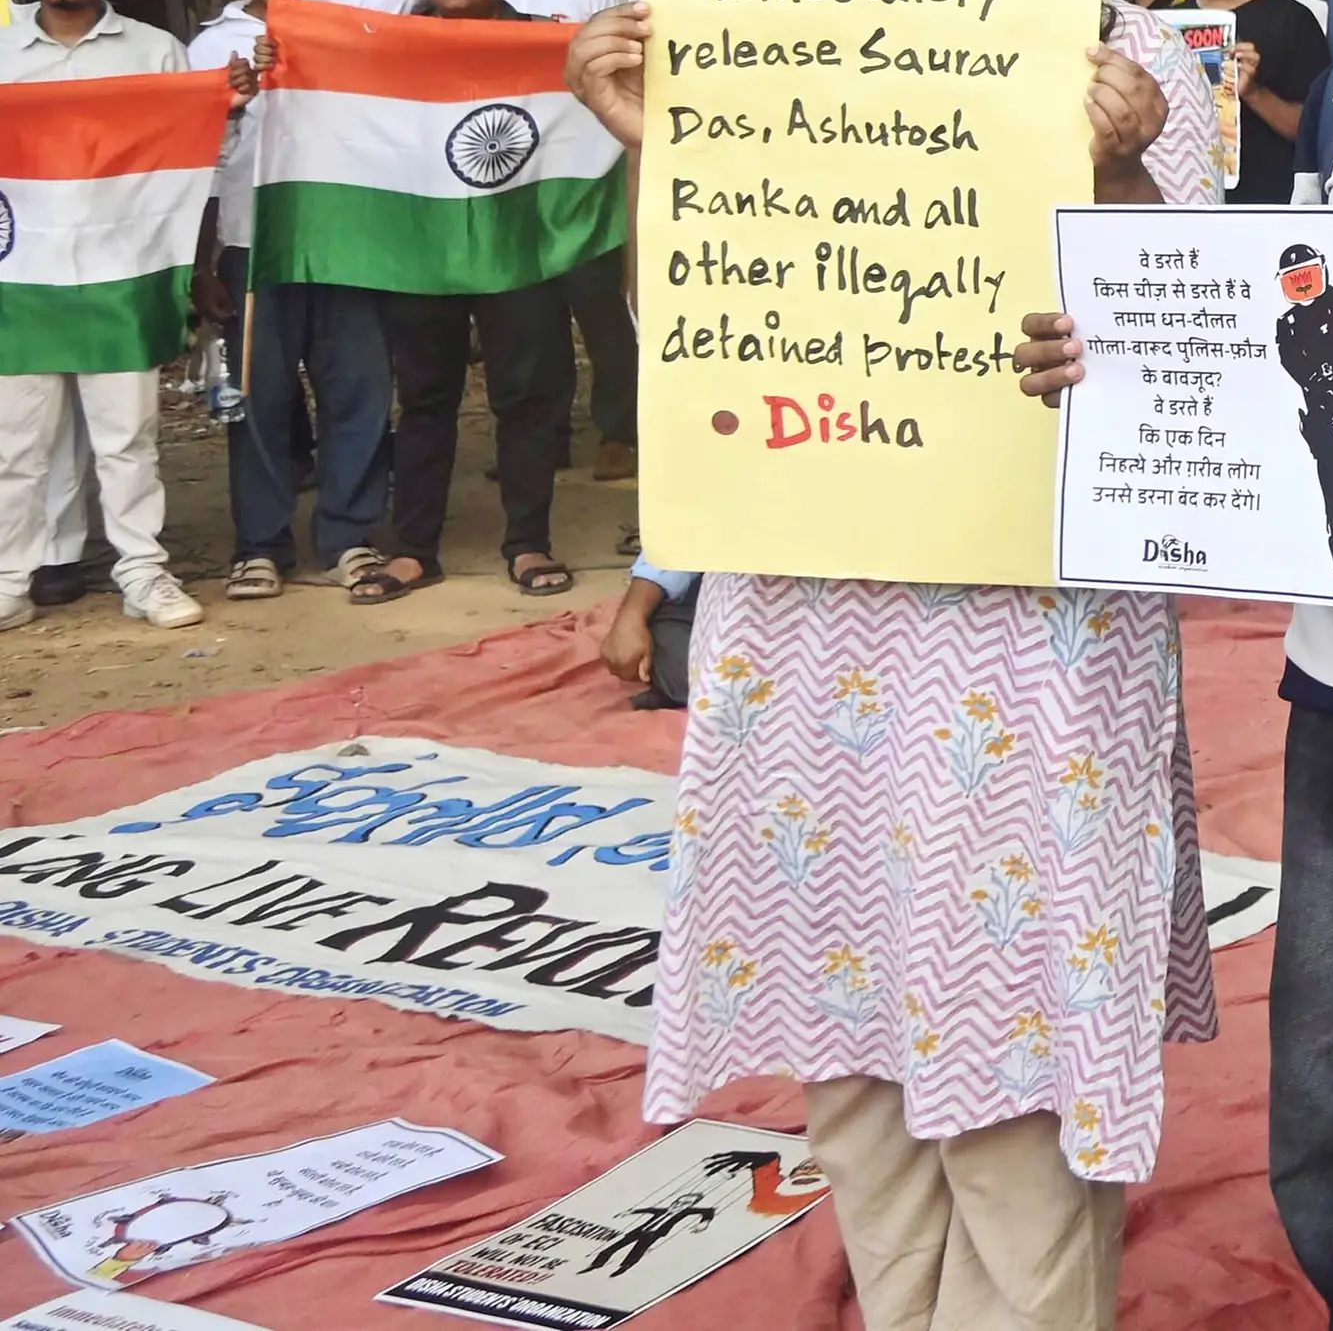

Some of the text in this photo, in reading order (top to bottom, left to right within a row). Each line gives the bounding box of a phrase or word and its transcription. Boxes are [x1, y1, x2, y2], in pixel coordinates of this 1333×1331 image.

[1184, 26, 1230, 48] SOON!
[668, 28, 1020, 78] release Saurav
[668, 99, 978, 156] Das, Ashutosh
[671, 178, 979, 228] Ranka and all
[1138, 247, 1200, 269] वे डरते हैं
[815, 242, 1005, 324] illegally
[1093, 277, 1251, 301] किस चीज़ से डरते हैं वे
[1113, 307, 1237, 329] तमाम धन-दौलत
[661, 310, 1029, 377] detained protest
[1176, 336, 1267, 363] पुलिस-फ़ौज
[1141, 364, 1157, 384] के
[1153, 394, 1214, 416] वे डरते हैं
[763, 394, 924, 450] Disha
[1139, 423, 1226, 448] कि एक दिन
[1152, 453, 1182, 476] और
[1227, 458, 1261, 480] लोग
[1092, 483, 1133, 503] उनसे
[1137, 488, 1174, 505] डरना
[1203, 492, 1226, 509] कर
[1142, 535, 1207, 565] Disha
[153, 860, 393, 930] LIVE
[499, 1232, 567, 1252] OF ECI
[471, 1247, 515, 1261] WILL
[508, 1253, 547, 1267] NOT
[404, 1277, 450, 1300] DISHA
